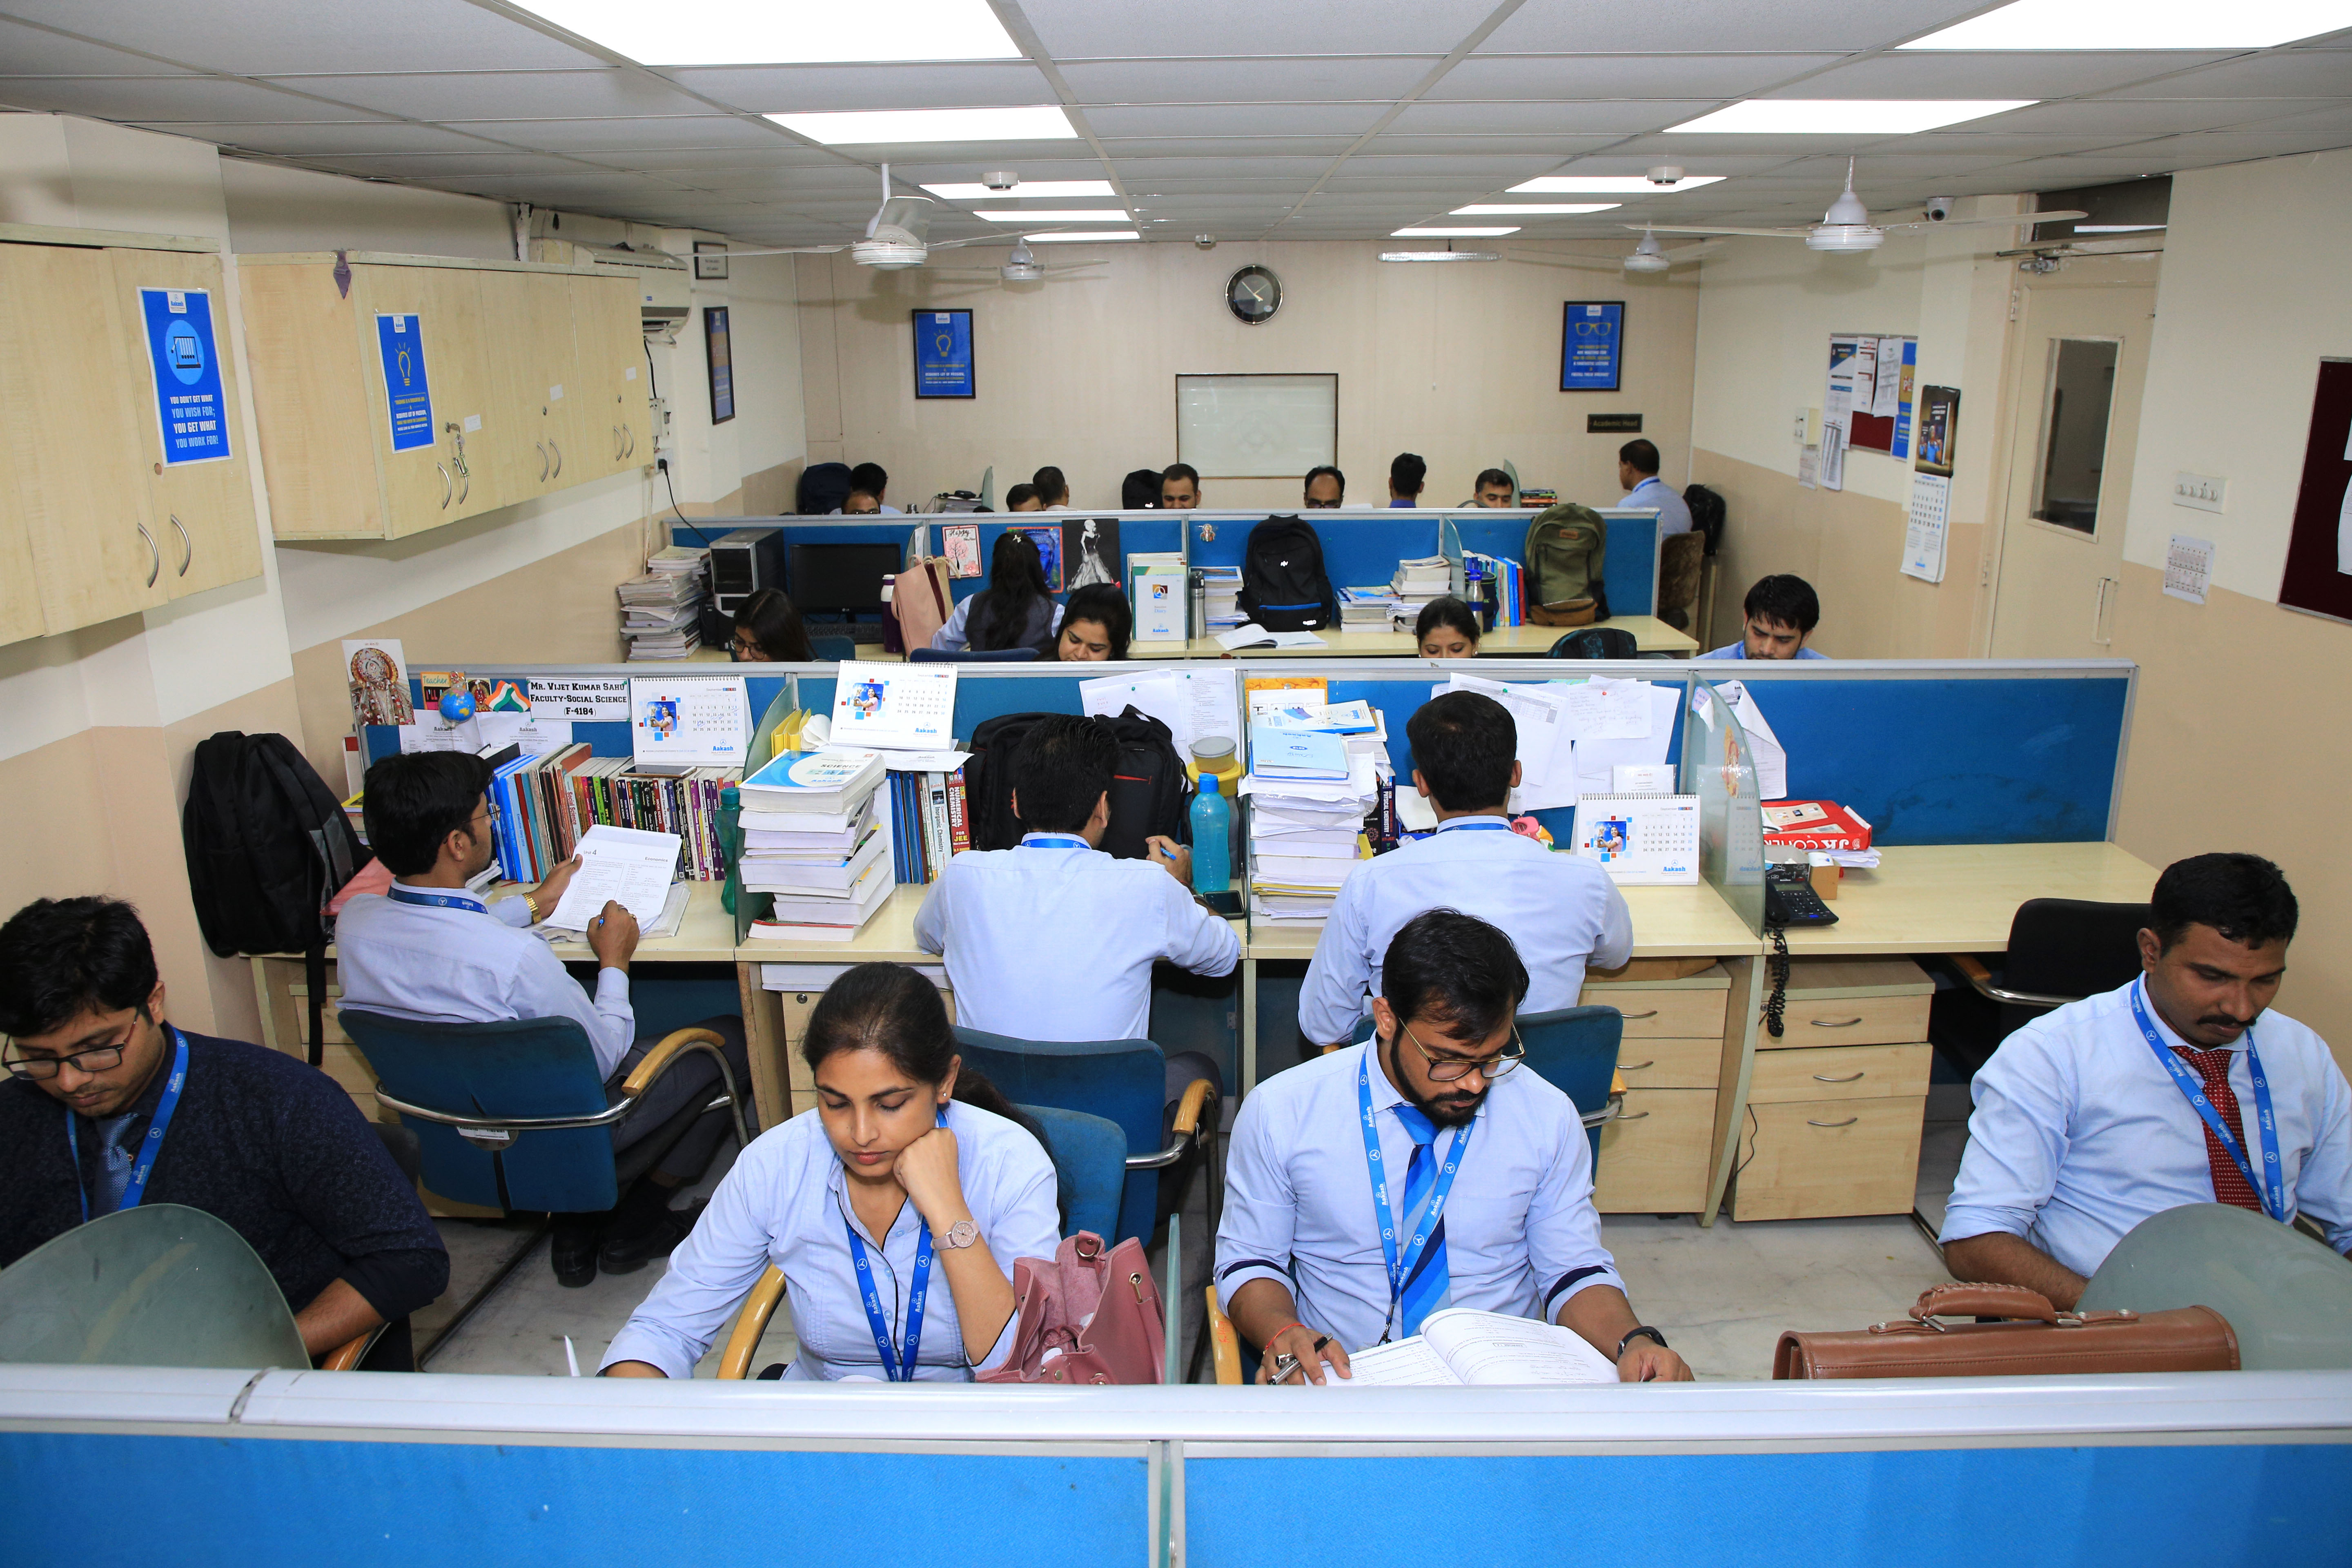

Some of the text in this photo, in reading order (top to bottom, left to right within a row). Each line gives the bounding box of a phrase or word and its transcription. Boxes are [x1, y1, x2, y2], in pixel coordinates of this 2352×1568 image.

[172, 406, 215, 418] YOU WISH FOR;
[173, 420, 216, 434] YOU GET WHAT
[176, 435, 218, 448] YOU WORK FOR!
[547, 682, 570, 690] VIJET
[530, 695, 593, 703] FACULTY-SOCIAL
[564, 708, 596, 717] (F-4184)
[949, 787, 958, 828] CHEMISTRY
[954, 786, 962, 828] NUMERICAL
[1821, 839, 1849, 849] JK
[2168, 1058, 2185, 1077] Aakash
[172, 1073, 181, 1093] Aakash
[2218, 1123, 2233, 1143] Aakash
[135, 1165, 146, 1184] Aakash
[1430, 1194, 1442, 1216] Aakash
[1397, 1266, 1409, 1287] Aakash
[871, 1292, 879, 1314] Aakash
